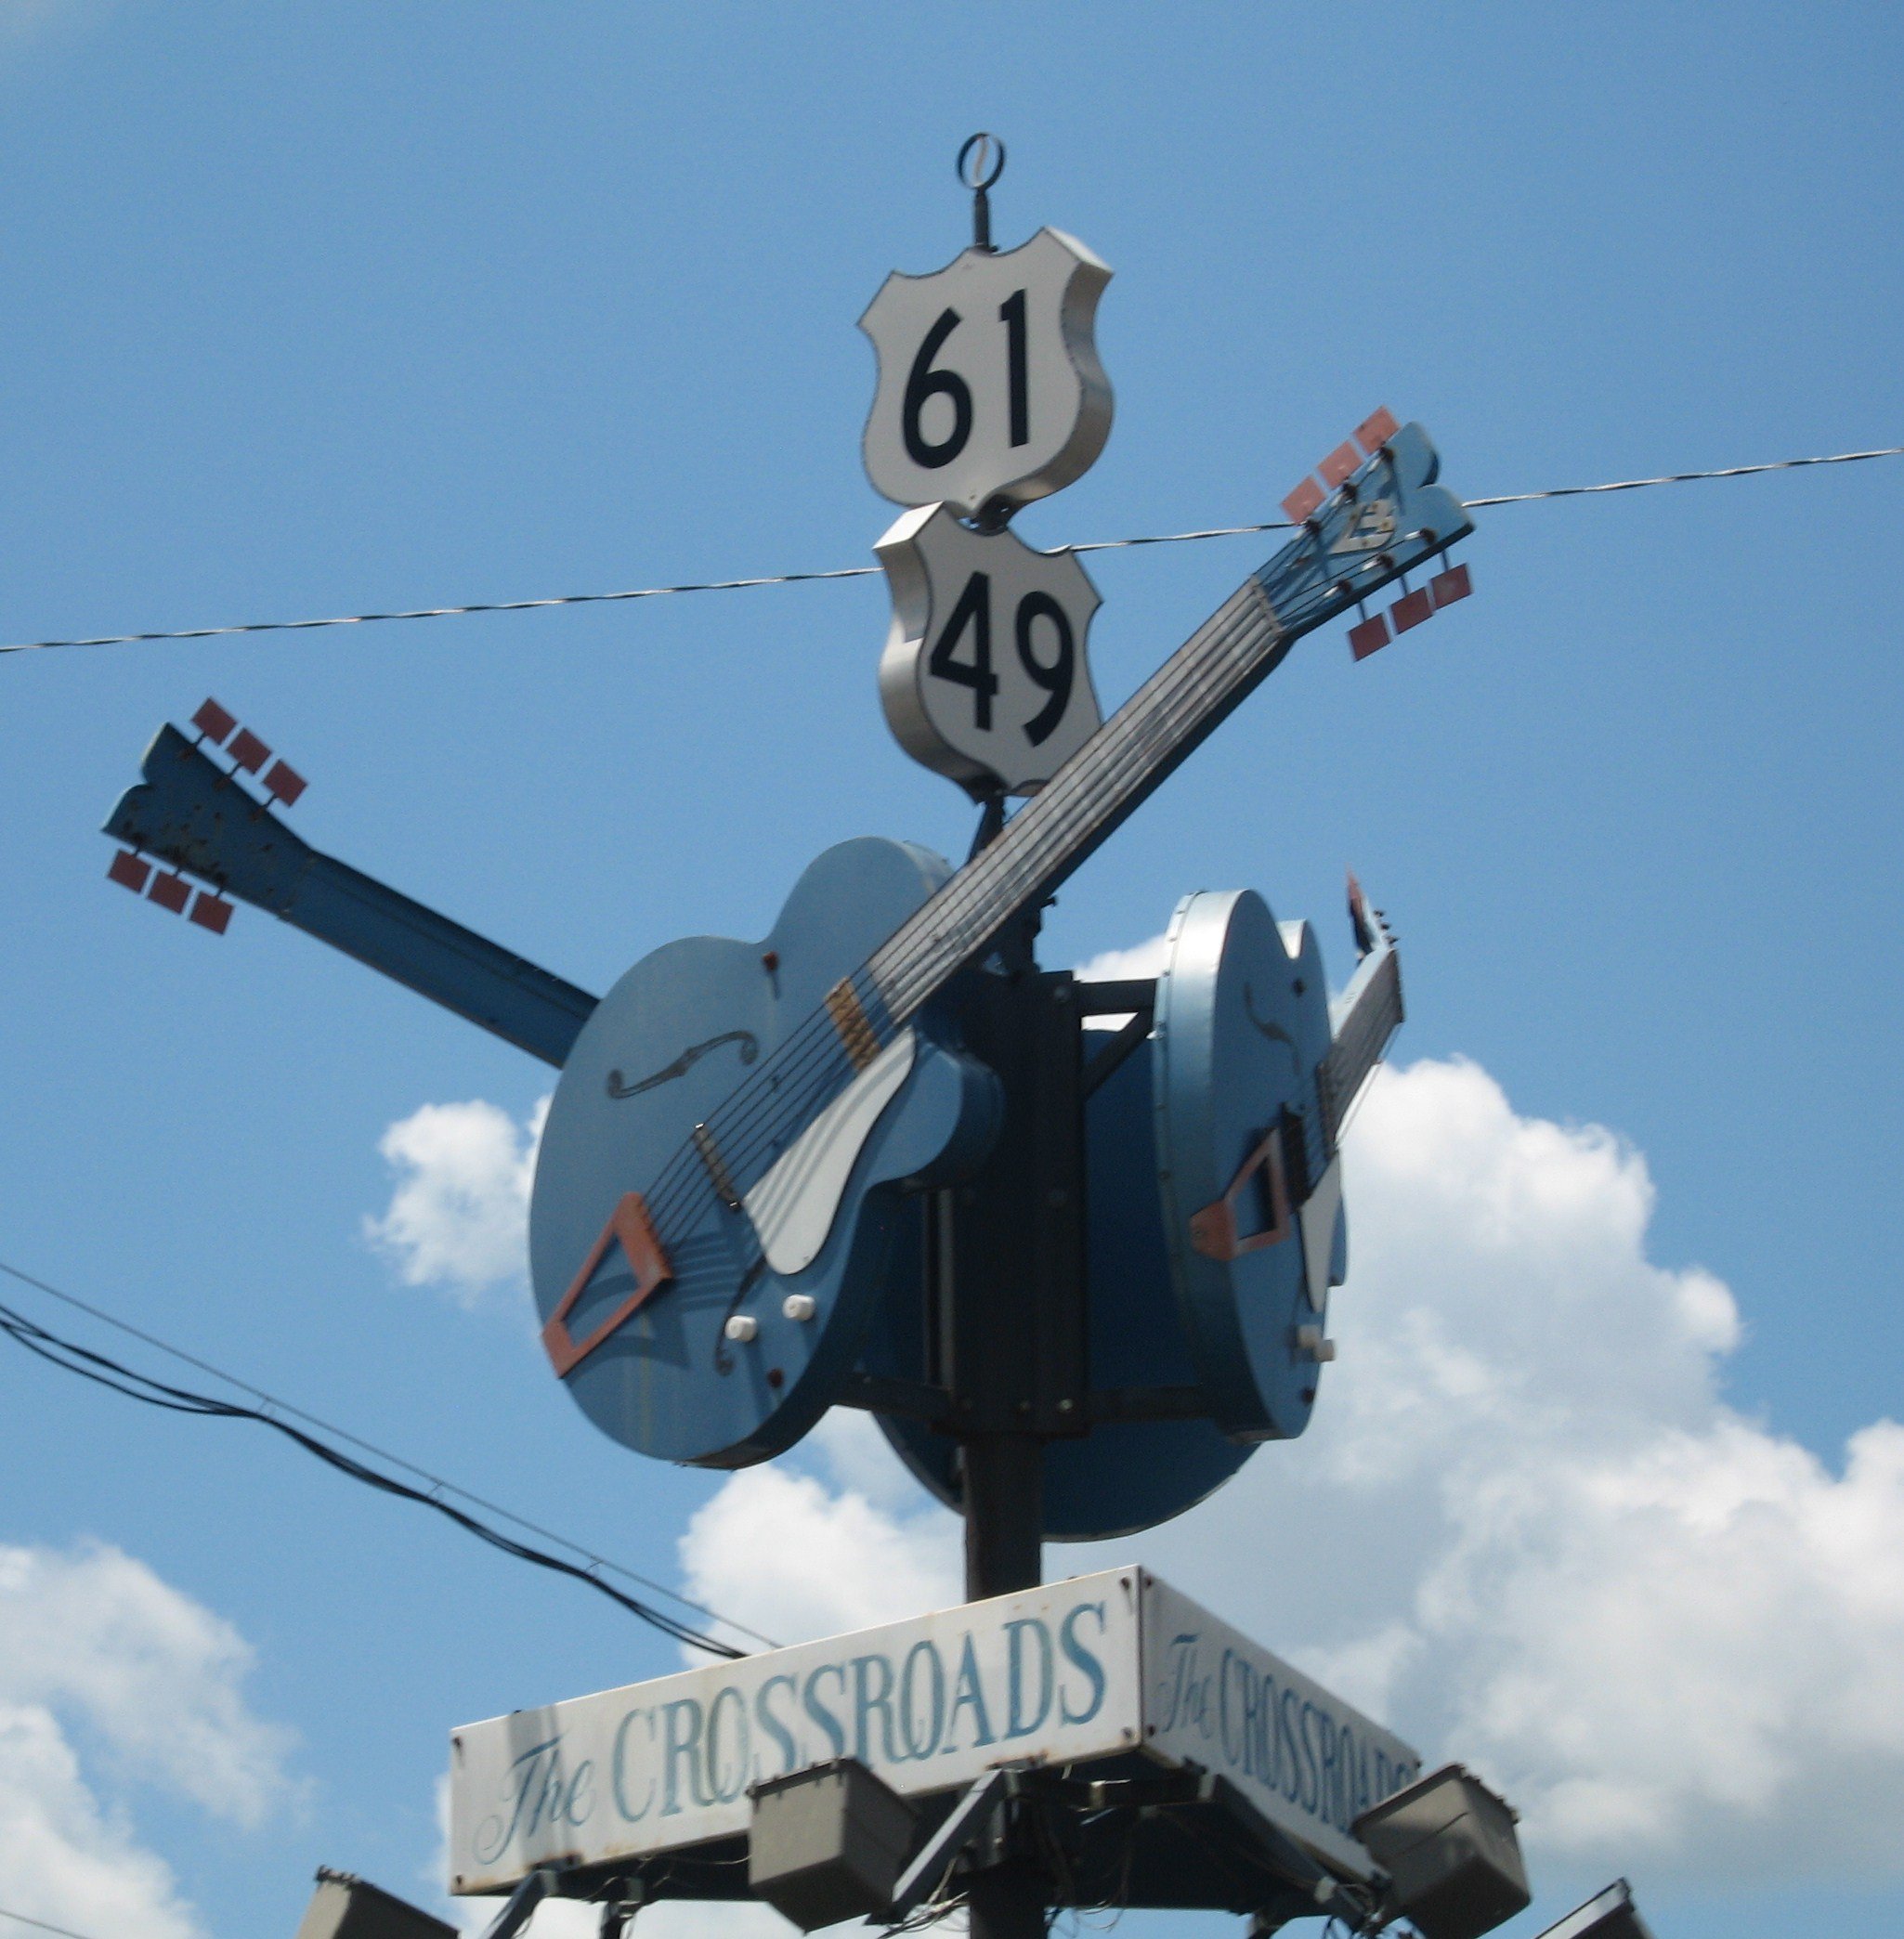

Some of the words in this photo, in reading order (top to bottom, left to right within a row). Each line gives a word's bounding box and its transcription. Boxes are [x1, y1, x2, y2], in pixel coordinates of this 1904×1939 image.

[903, 287, 1029, 469] 61
[930, 570, 1075, 748] 49
[472, 1735, 596, 1865] The
[610, 1601, 1106, 1822] CROSSROADS
[1158, 1633, 1213, 1739] The
[1219, 1647, 1415, 1837] CROSSROA
